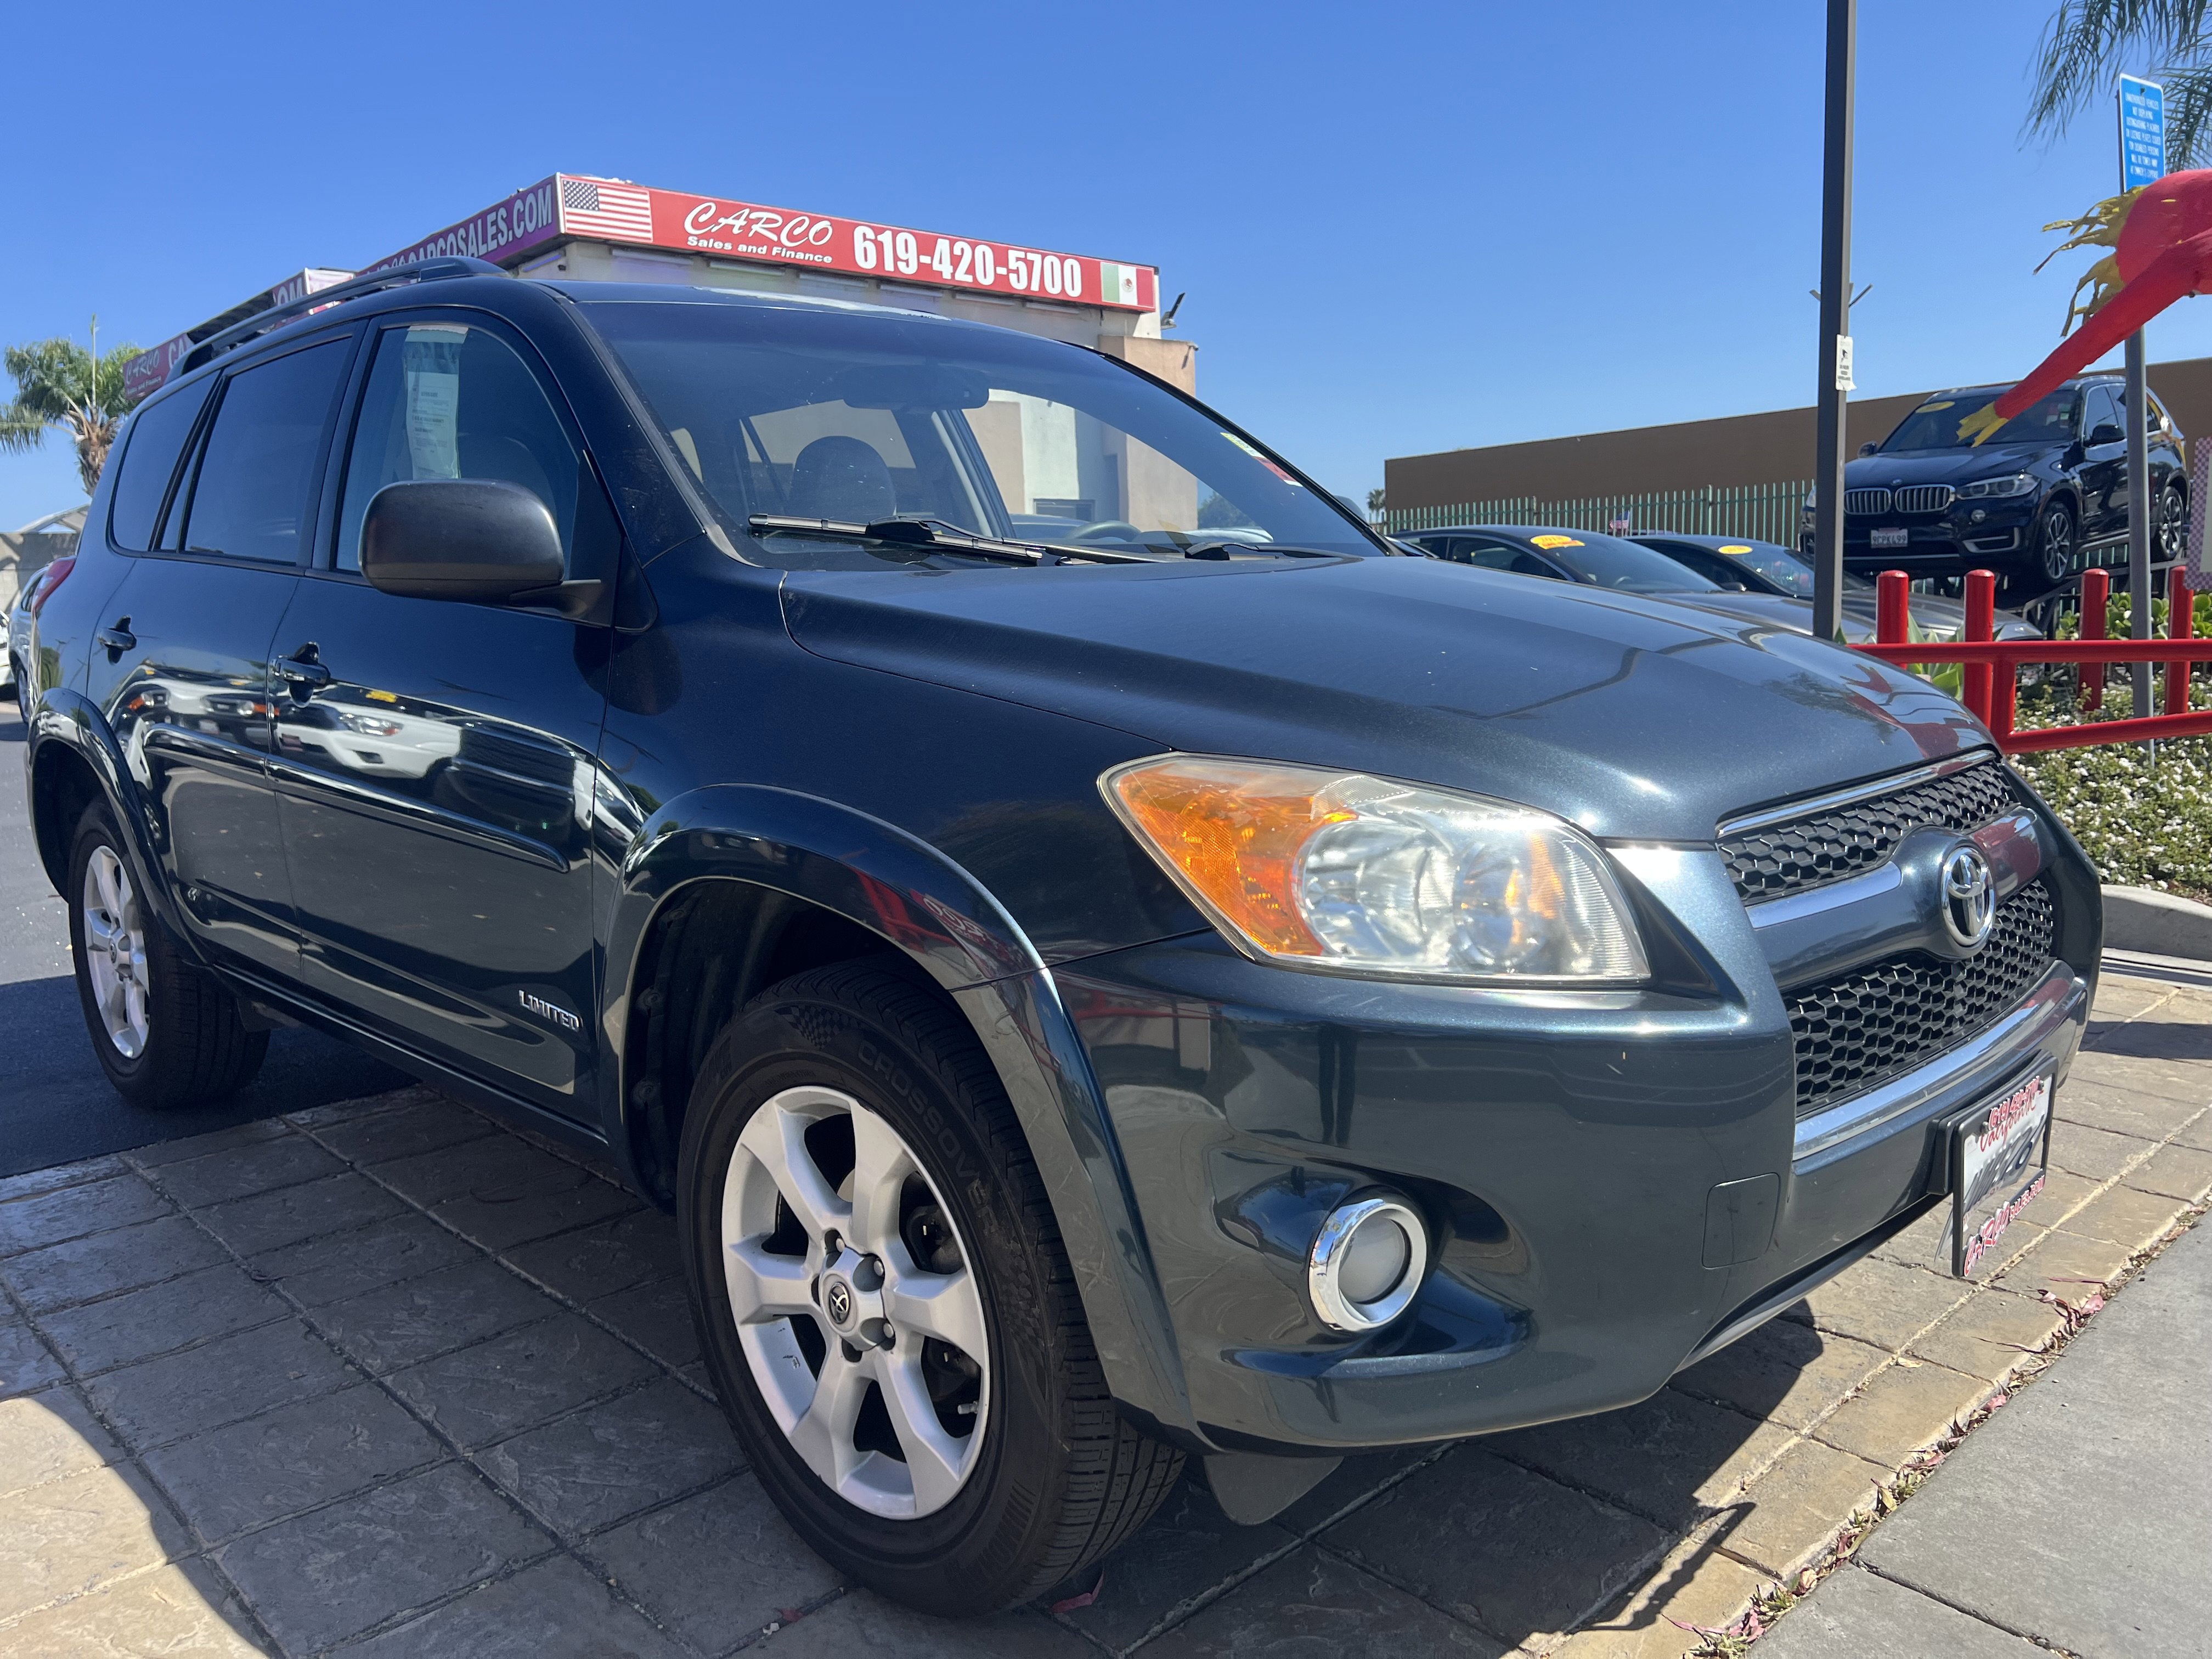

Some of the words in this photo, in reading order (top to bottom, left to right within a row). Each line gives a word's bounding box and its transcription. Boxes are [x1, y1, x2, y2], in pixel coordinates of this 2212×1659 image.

[684, 202, 833, 247] CARCO
[687, 235, 733, 250] Sales
[737, 242, 768, 255] and
[771, 246, 833, 263] Finance
[853, 225, 1081, 297] 619-420-5700
[518, 989, 584, 1032] LIMITED
